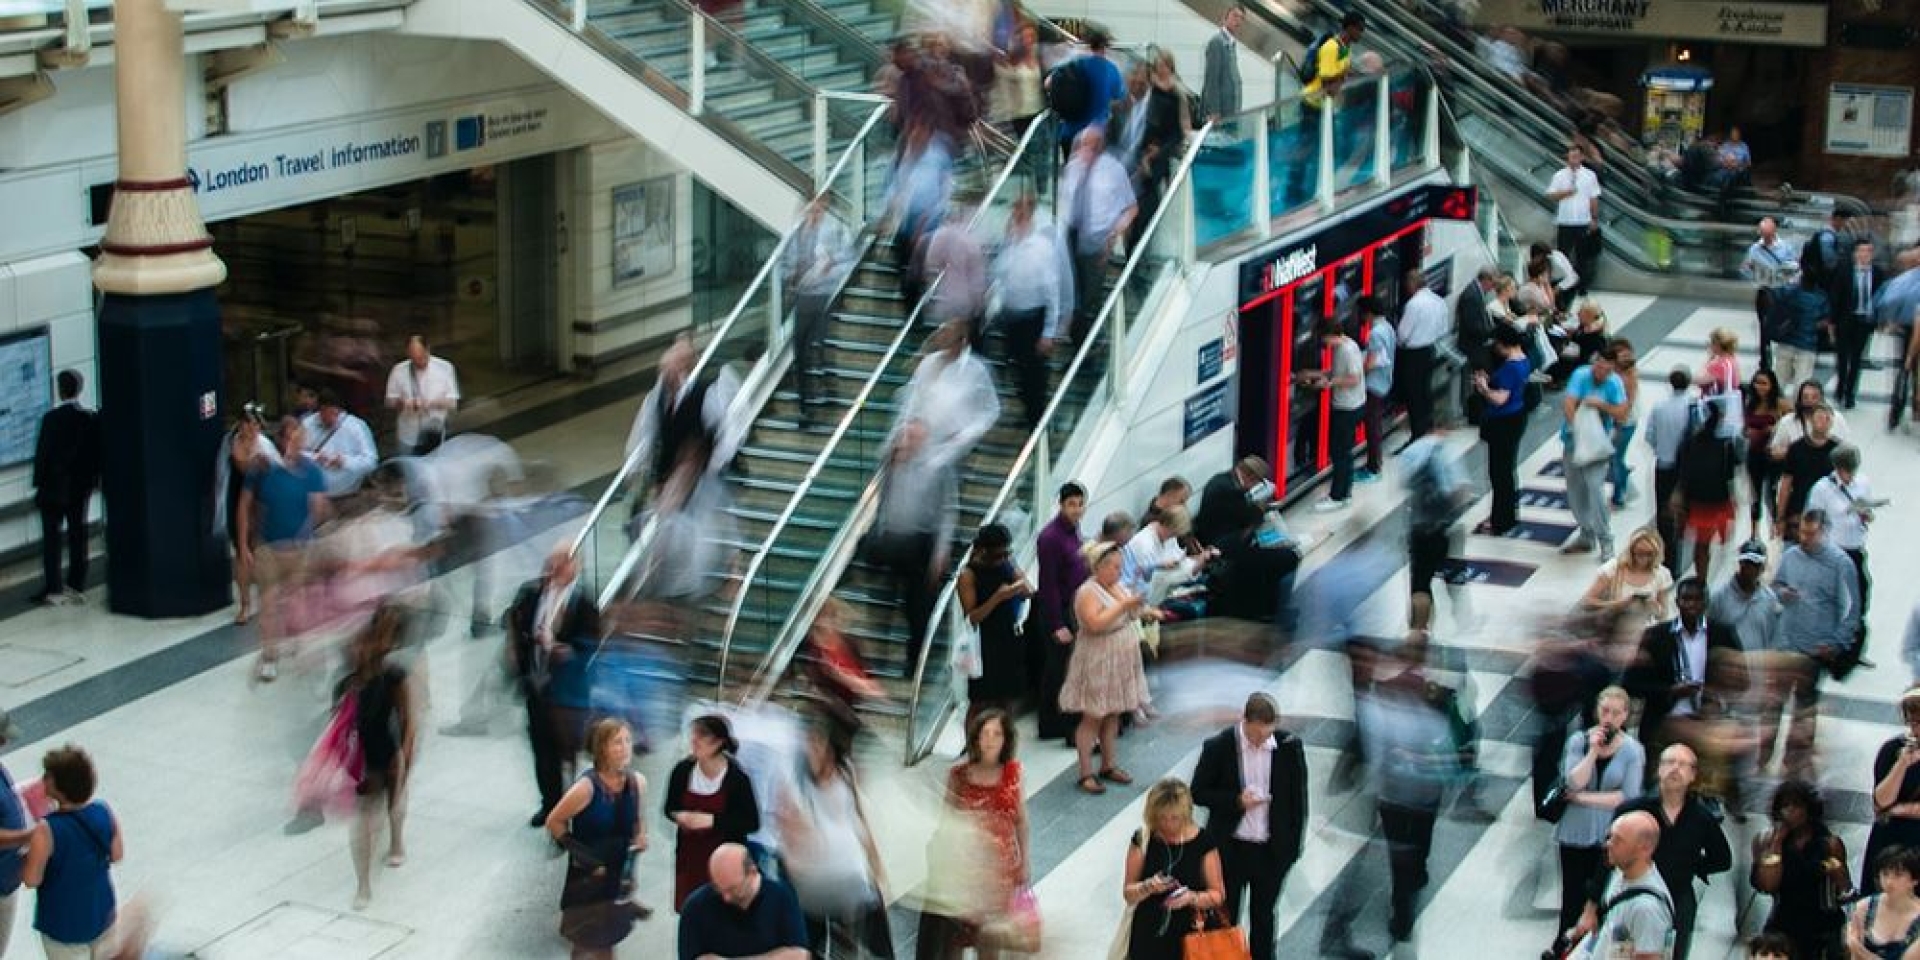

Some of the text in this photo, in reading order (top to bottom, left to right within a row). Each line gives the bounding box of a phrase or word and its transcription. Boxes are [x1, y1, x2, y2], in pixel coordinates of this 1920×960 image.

[206, 134, 420, 192] London Travel Information
[1274, 243, 1317, 288] NatWest
